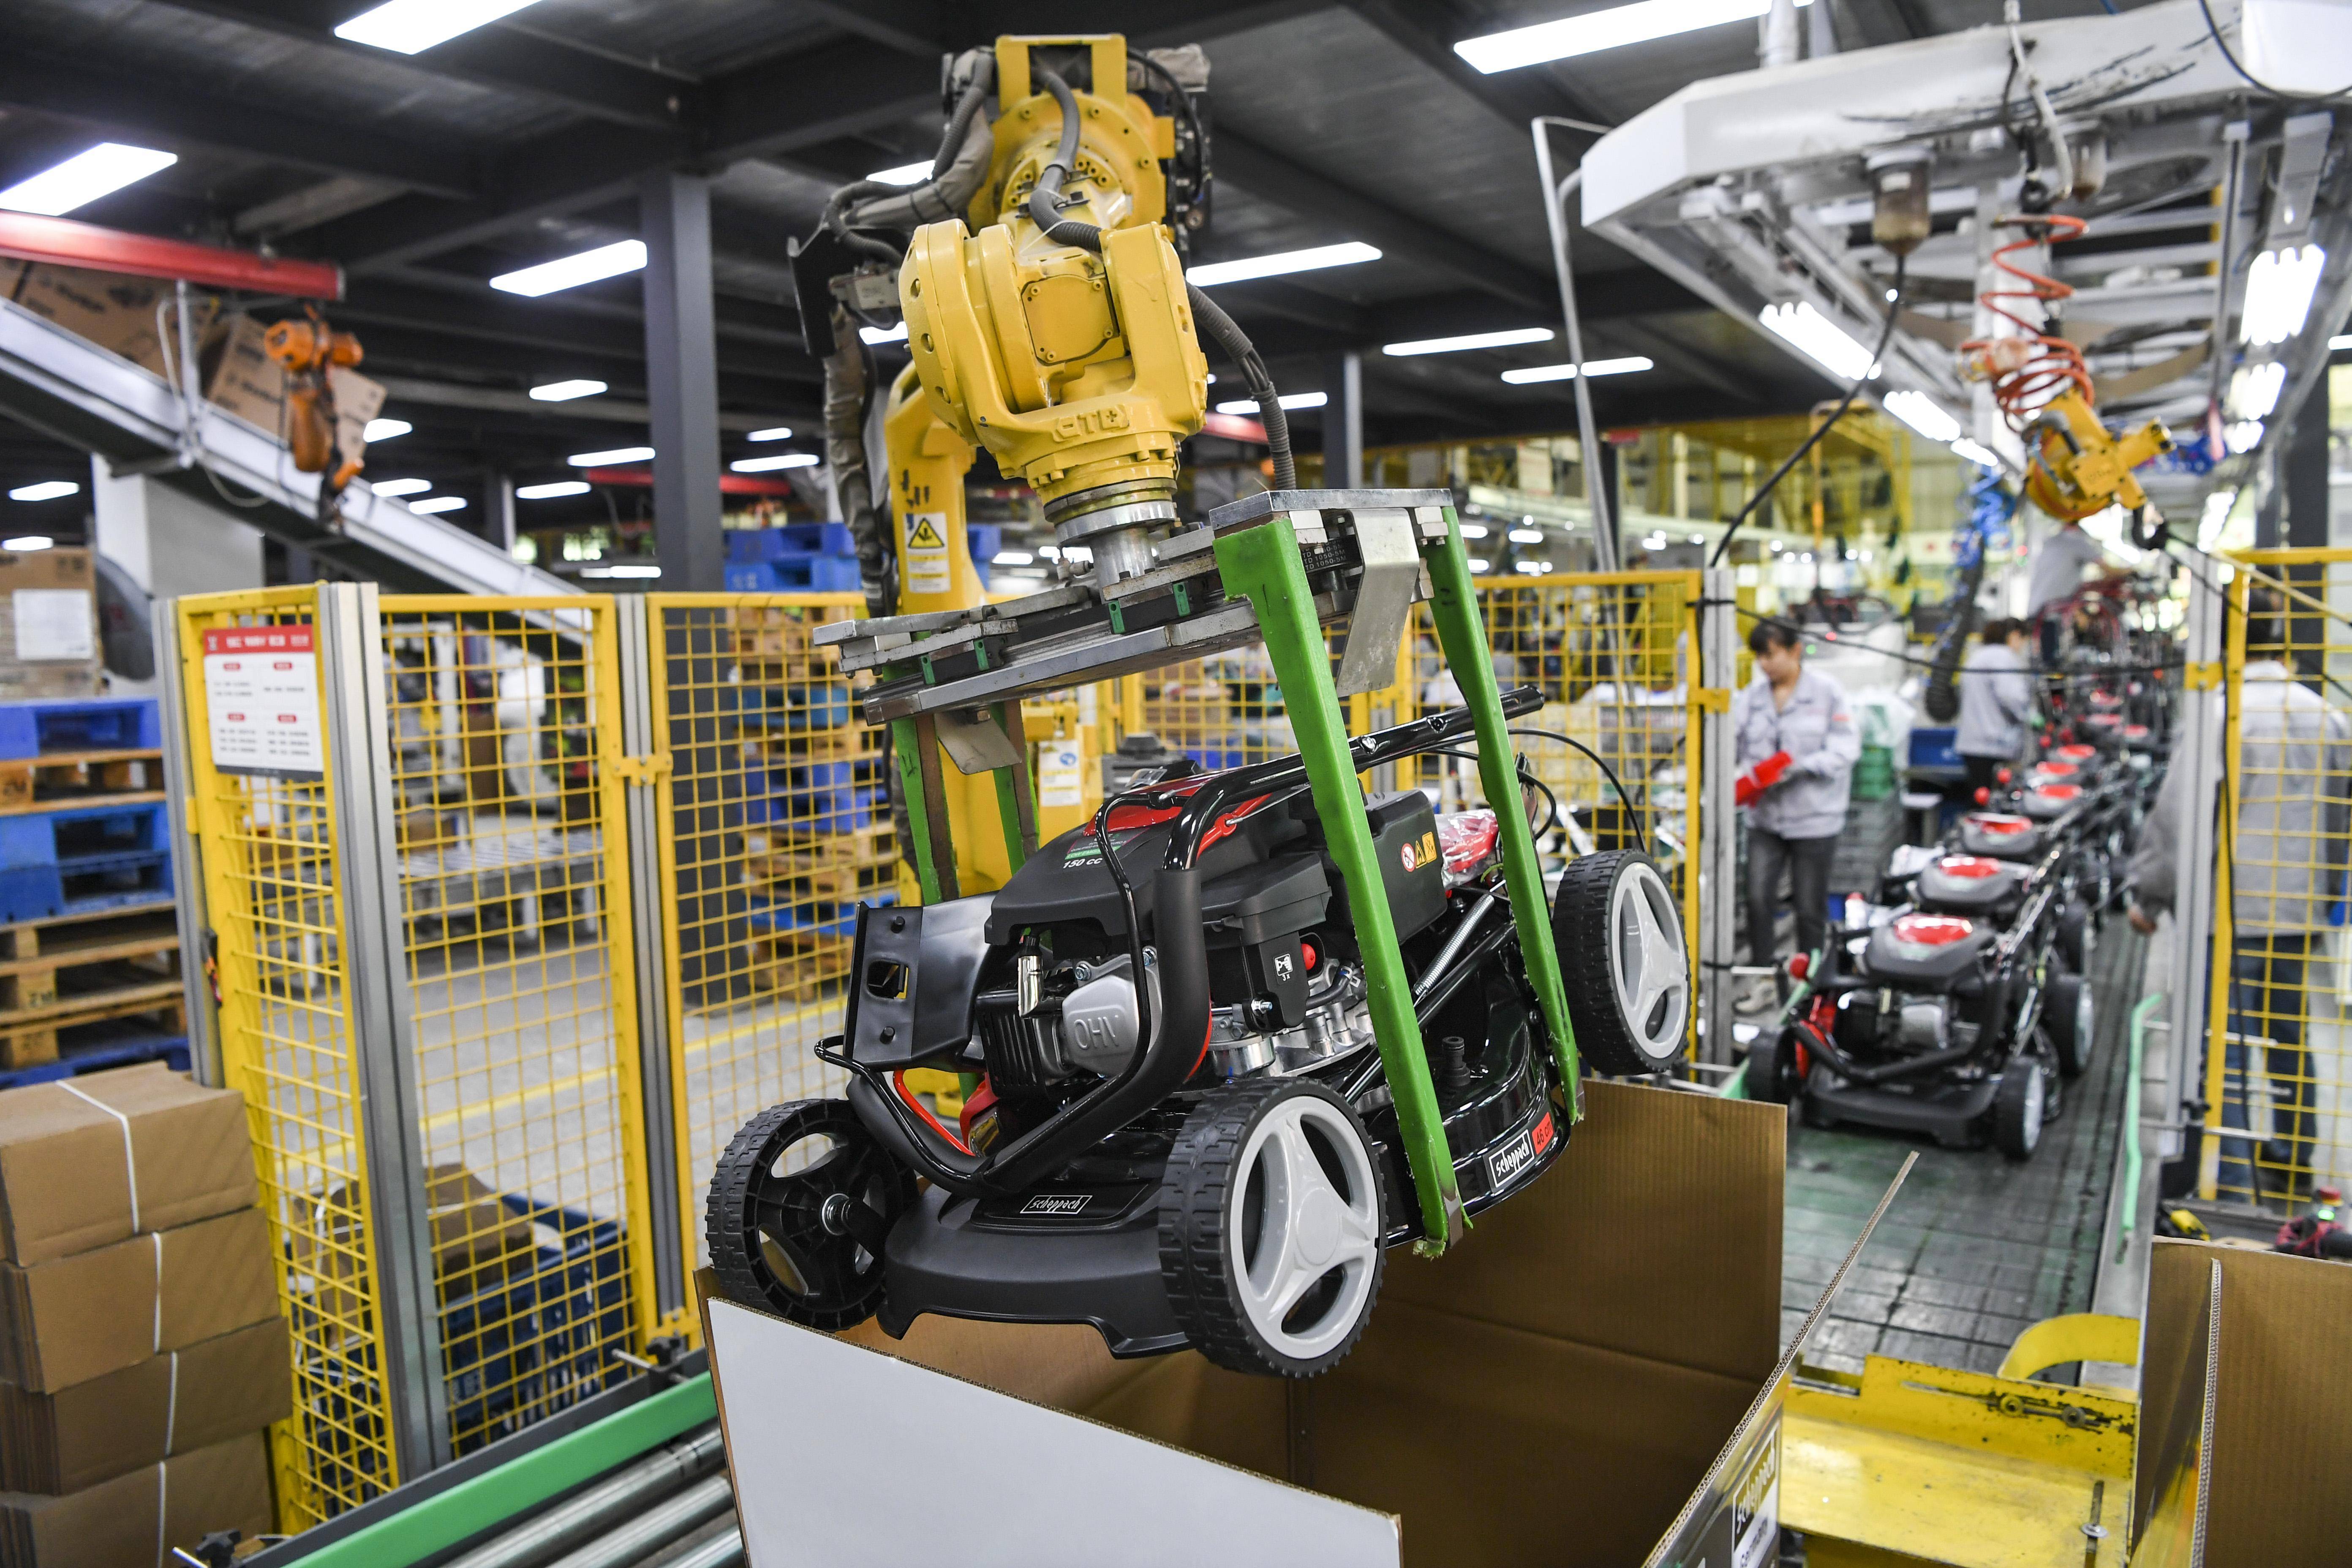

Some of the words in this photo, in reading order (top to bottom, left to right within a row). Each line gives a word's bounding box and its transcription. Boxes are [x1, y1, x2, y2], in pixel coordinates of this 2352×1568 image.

[1315, 550, 1345, 561] 1050-5M
[1317, 555, 1346, 567] 1050-5M
[1063, 859, 1085, 868] 150
[1496, 1135, 1530, 1177] scheppach
[1537, 1129, 1544, 1146] 46
[1545, 1122, 1552, 1137] cm
[1029, 1195, 1083, 1213] scheppach
